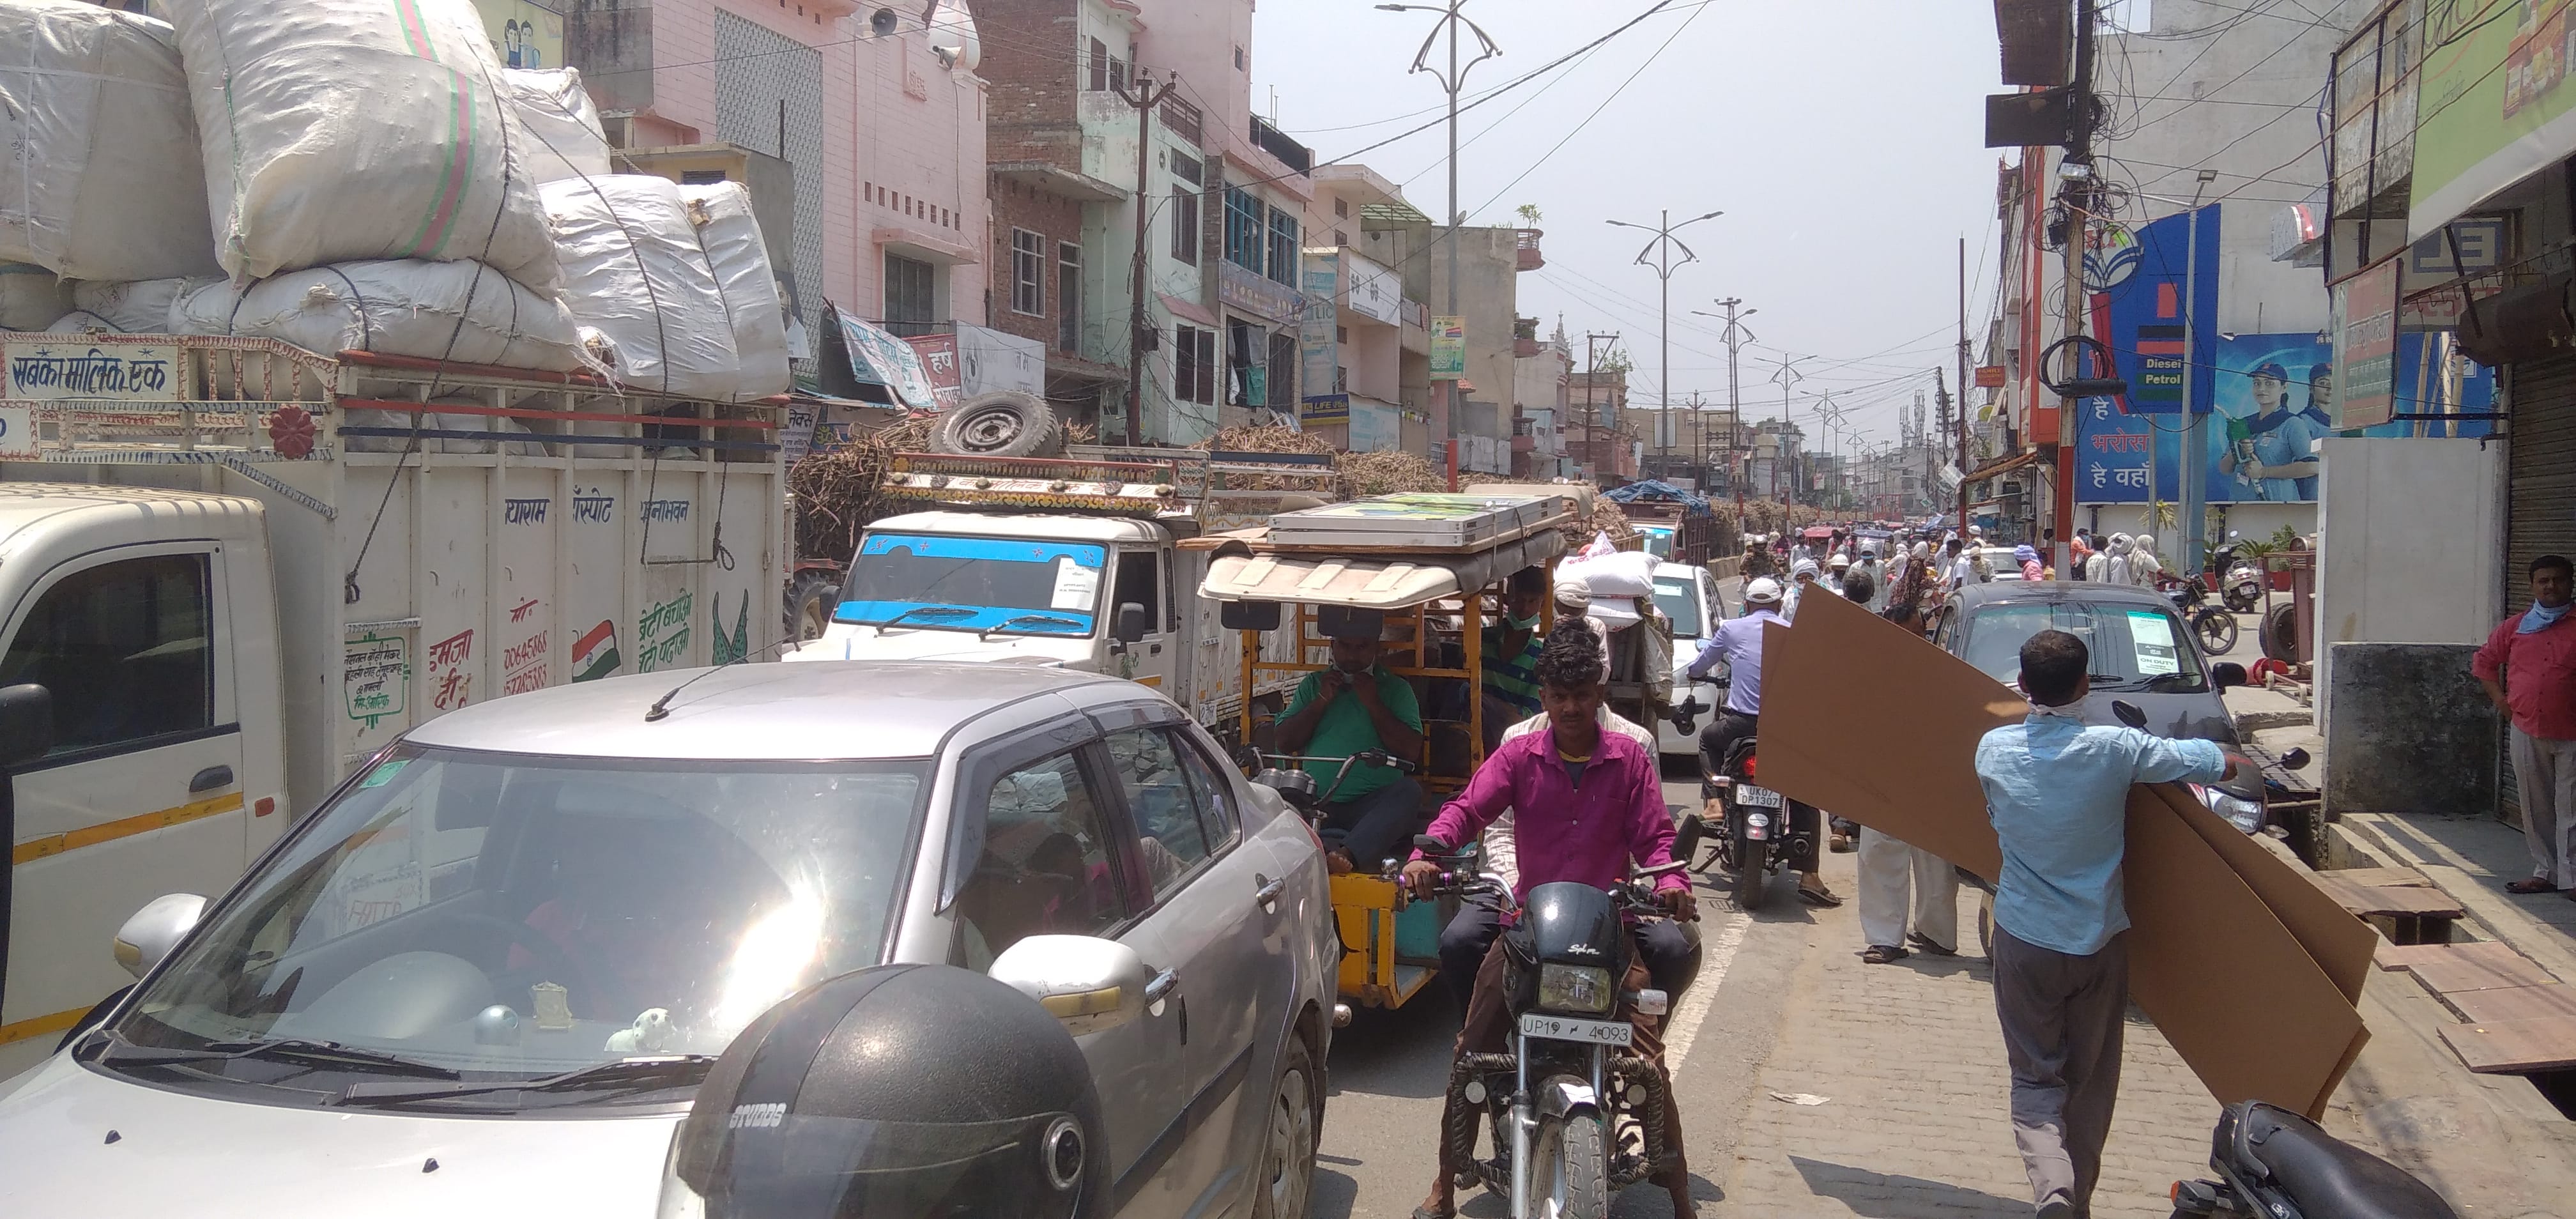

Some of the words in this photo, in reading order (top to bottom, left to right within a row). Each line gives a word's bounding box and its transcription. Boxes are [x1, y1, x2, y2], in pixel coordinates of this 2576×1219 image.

[65, 348, 126, 394] मालिक
[129, 360, 168, 394] एक
[927, 342, 954, 375] हर्ष
[2146, 358, 2182, 369] Diesel
[2145, 374, 2181, 385] Petrol
[1314, 401, 1332, 410] LIFE
[2091, 427, 2150, 453] भरोस
[2090, 461, 2108, 489] है
[1523, 1018, 1561, 1035] UP19
[1589, 1026, 1629, 1041] 4093
[729, 1102, 787, 1129] STUDDS
